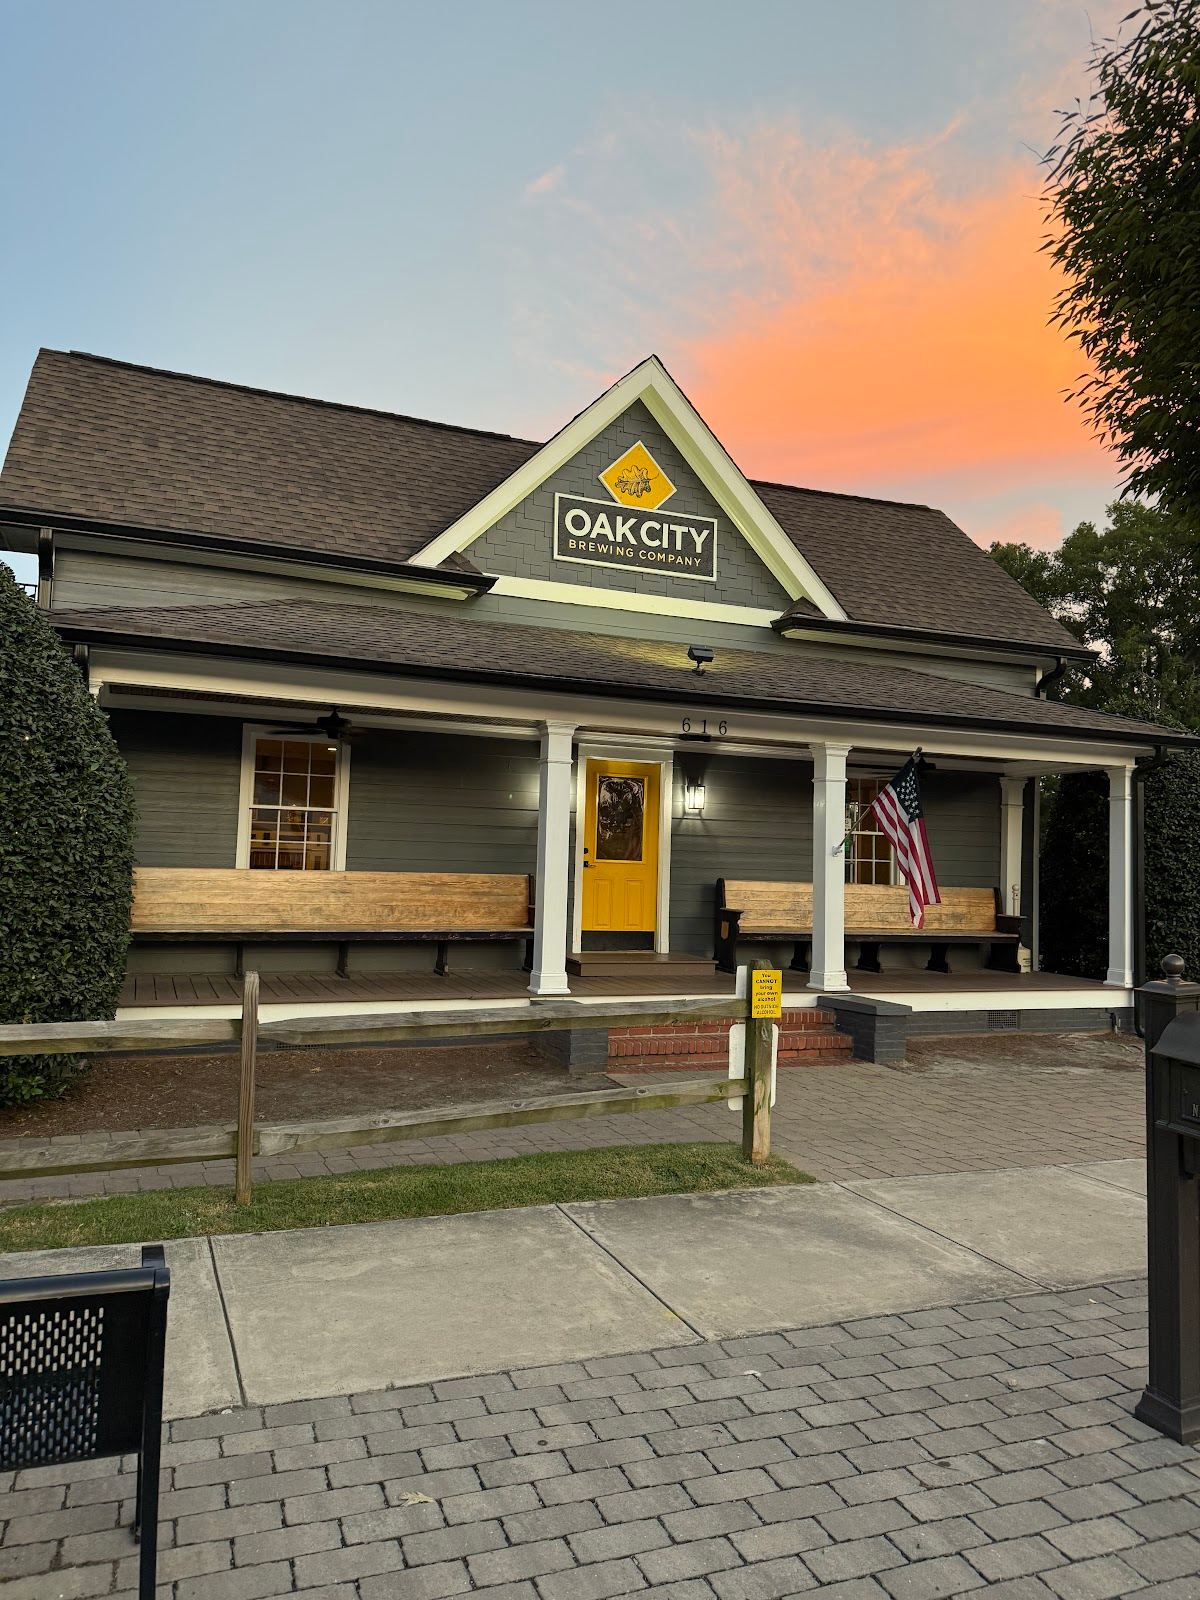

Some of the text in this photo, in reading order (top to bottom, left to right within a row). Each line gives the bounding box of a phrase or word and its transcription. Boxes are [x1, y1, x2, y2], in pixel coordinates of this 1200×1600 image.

[565, 508, 710, 554] OAK CITY
[569, 539, 702, 567] BREWING COMPANY
[682, 717, 728, 736] 616
